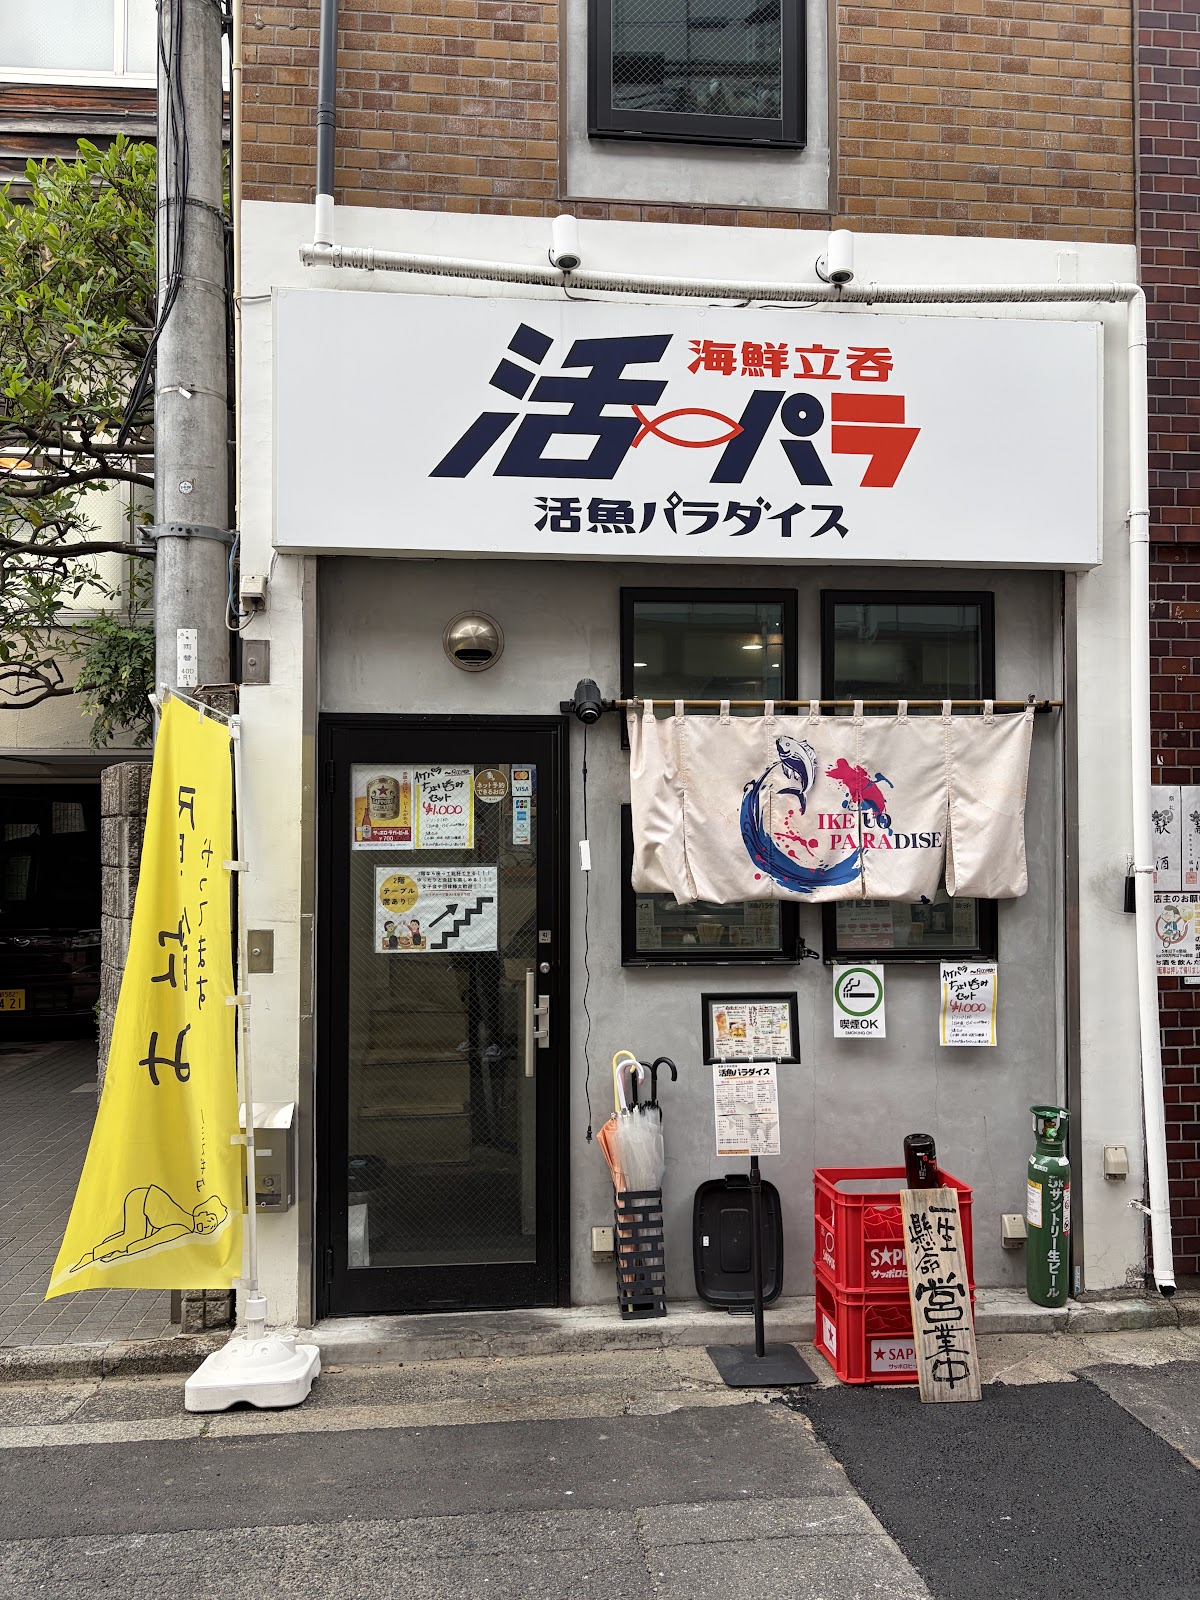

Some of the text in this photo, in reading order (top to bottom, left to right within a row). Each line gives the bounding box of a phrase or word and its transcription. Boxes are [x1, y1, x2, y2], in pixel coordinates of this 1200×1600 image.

[686, 339, 894, 382] 海鮮立呑
[534, 490, 850, 539] 活魚パラダイス
[477, 781, 505, 789] ネット予約
[429, 793, 452, 803] セット
[818, 813, 892, 829] IKE UO
[830, 832, 942, 850] PARADISE
[383, 887, 415, 895] テーブル
[1153, 894, 1200, 904] 店主のお願
[942, 965, 968, 981] イケパラ
[948, 977, 988, 992] ちょい呑み
[955, 992, 977, 1001] セット
[840, 1019, 879, 1029] 喫煙OK
[718, 1067, 770, 1077] 活魚パラダイス
[1047, 1188, 1063, 1298] サントリー生ビール
[915, 1271, 971, 1390] 営業中
[888, 1348, 917, 1361] SAP
